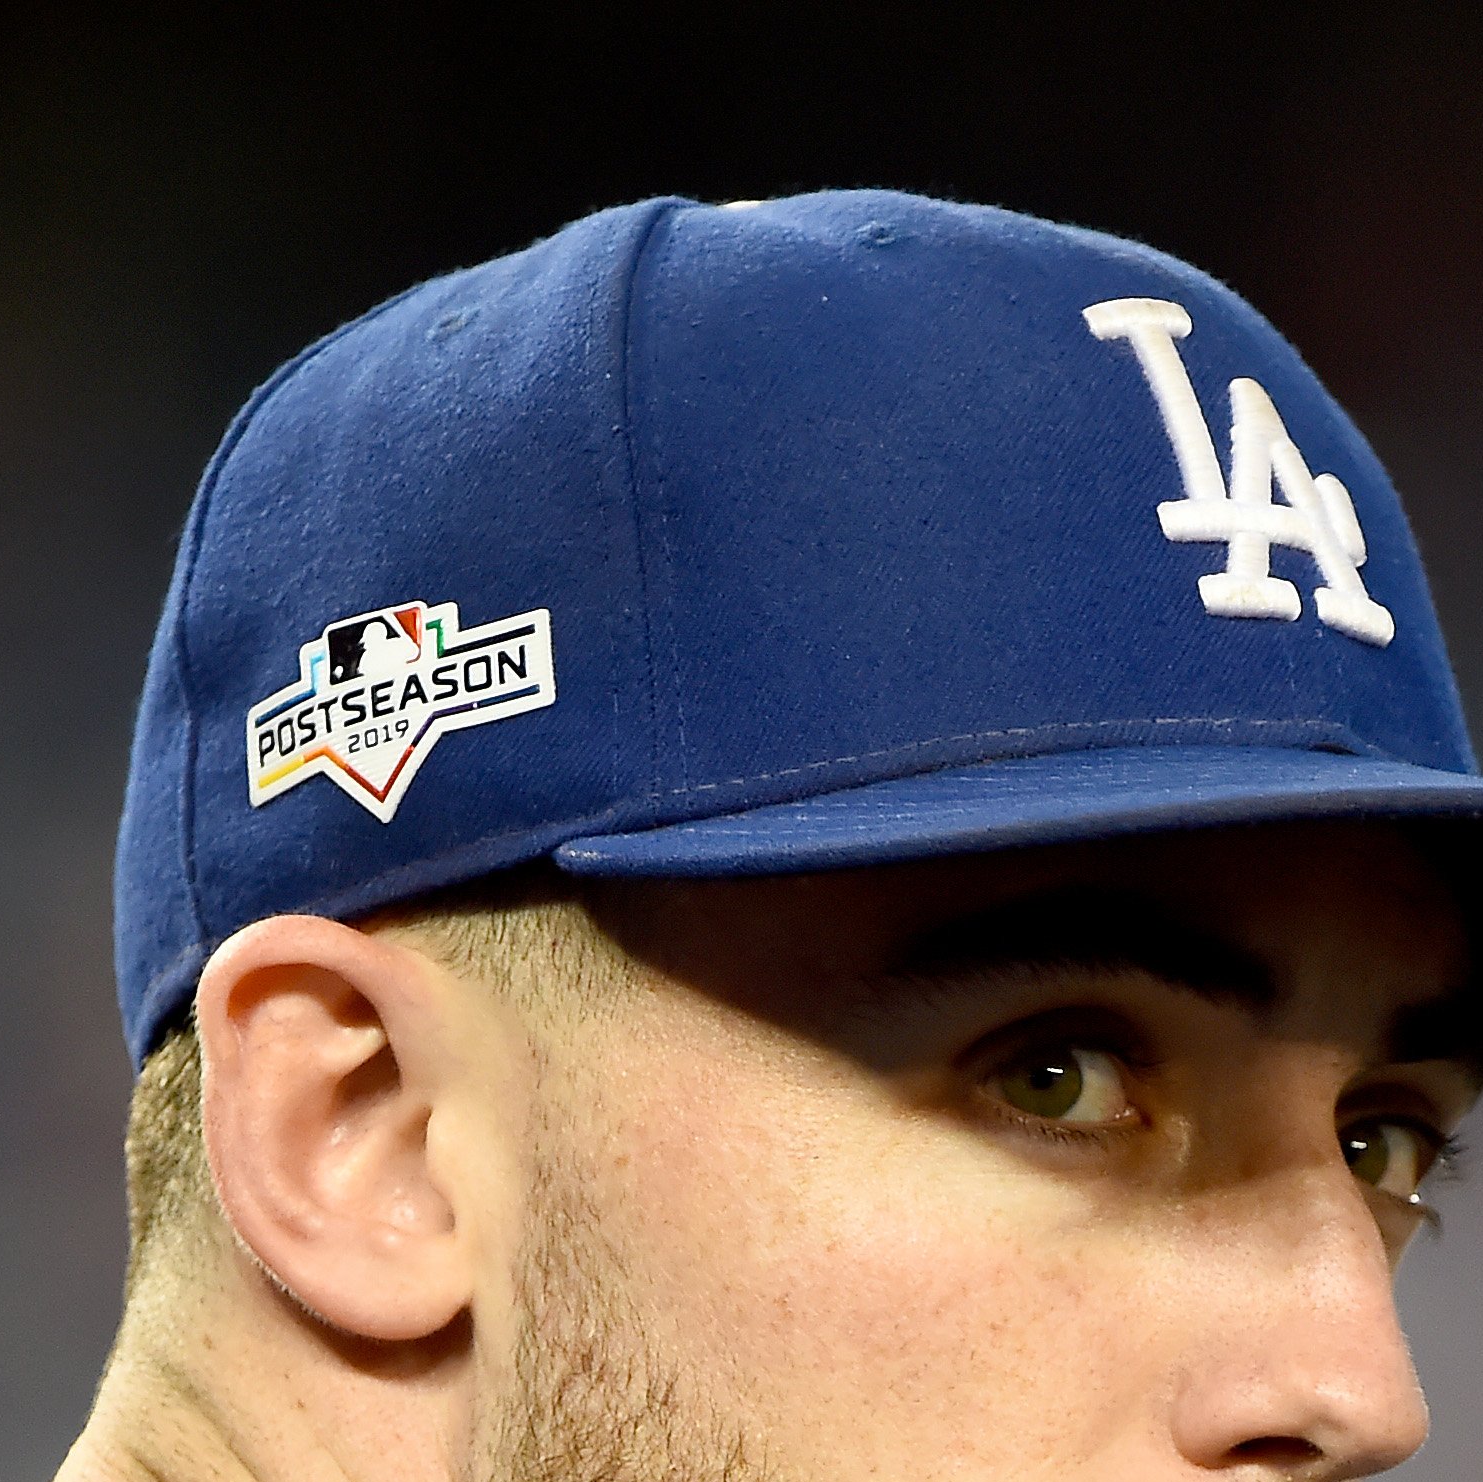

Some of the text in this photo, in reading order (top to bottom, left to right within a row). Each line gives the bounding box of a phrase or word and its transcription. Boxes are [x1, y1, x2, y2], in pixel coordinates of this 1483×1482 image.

[1081, 297, 1396, 648] LA
[258, 644, 529, 768] POSTSEASON
[347, 719, 409, 754] 2019
